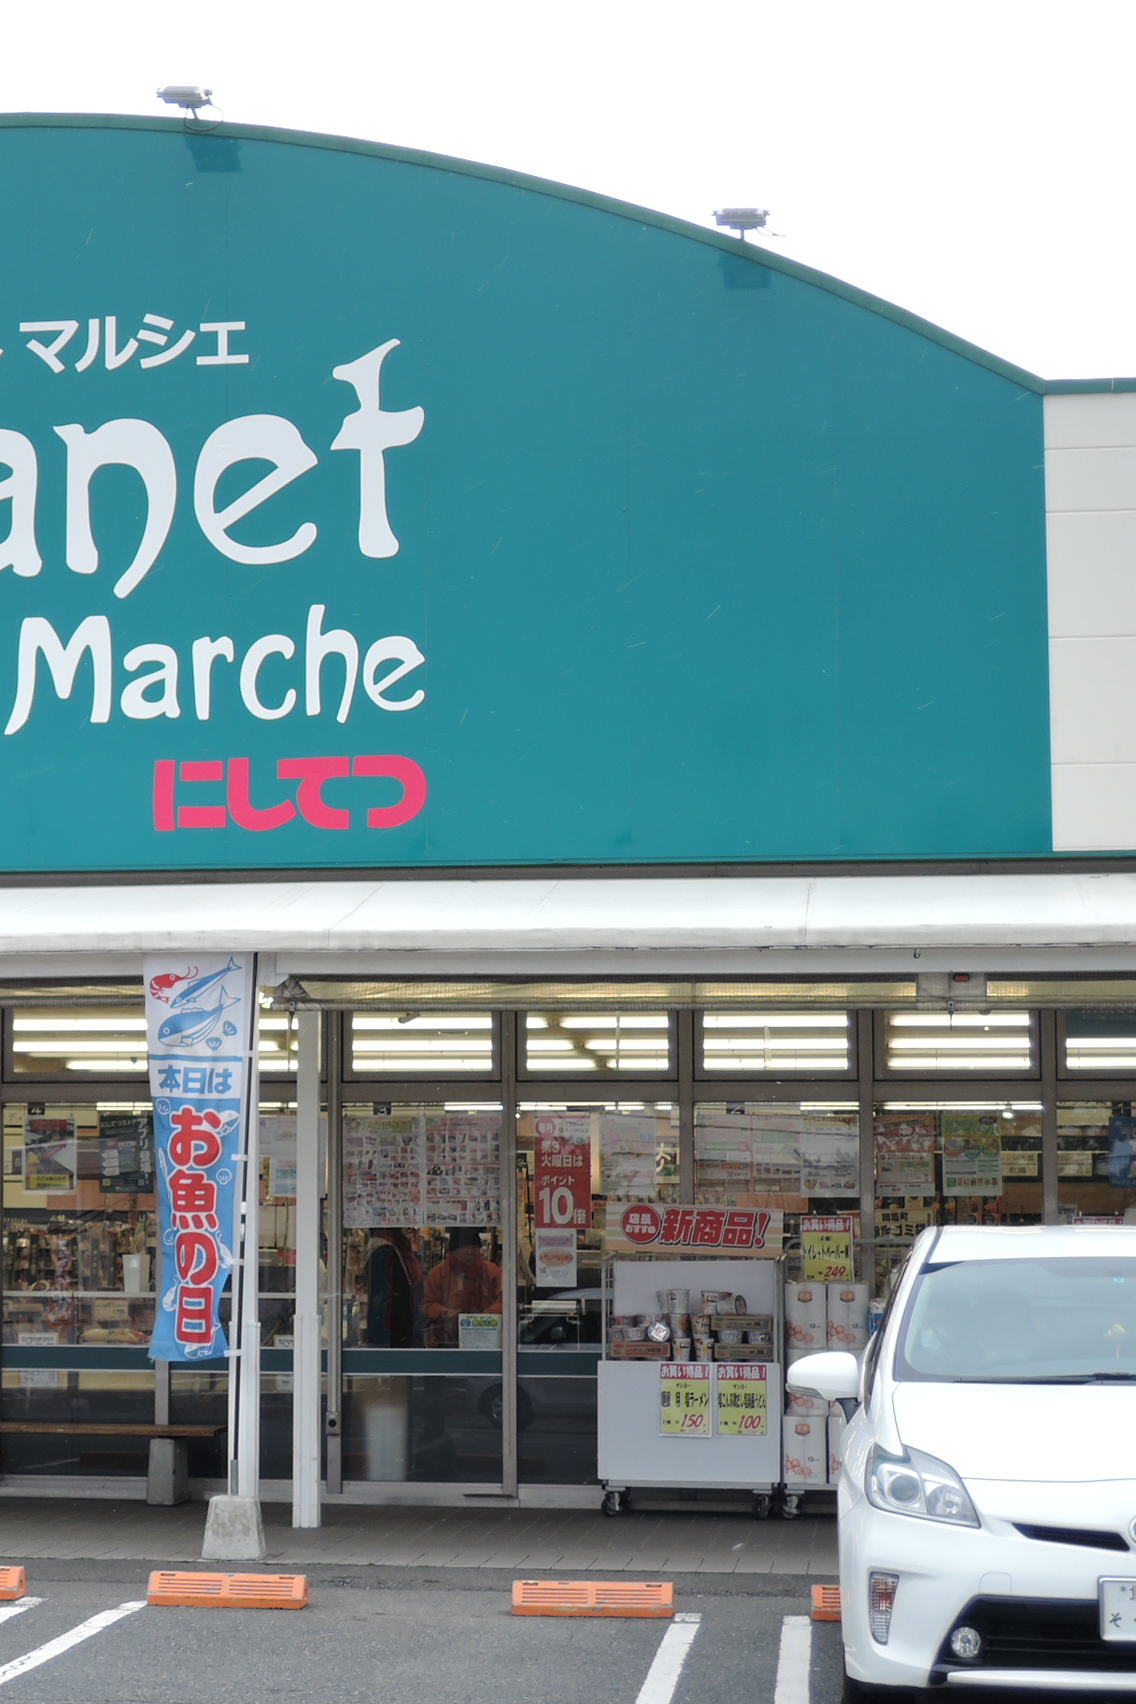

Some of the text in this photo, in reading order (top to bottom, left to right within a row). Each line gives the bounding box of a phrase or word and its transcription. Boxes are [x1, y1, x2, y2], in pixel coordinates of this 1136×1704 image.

[19, 313, 250, 376] マルシエ
[3, 604, 425, 735] Marche
[153, 754, 427, 831] にしてつ
[157, 1064, 232, 1094] 本日は
[541, 1154, 583, 1168] 火曜日は
[541, 1175, 575, 1186] ポイント
[539, 1186, 587, 1225] 10倍
[168, 1107, 222, 1346] お魚の日
[625, 1224, 657, 1234] おすすめ
[628, 1213, 652, 1224] 店長
[659, 1206, 770, 1249] 新商品!
[824, 1265, 846, 1278] 249
[681, 1414, 704, 1428] 150
[738, 1415, 762, 1429] 100
